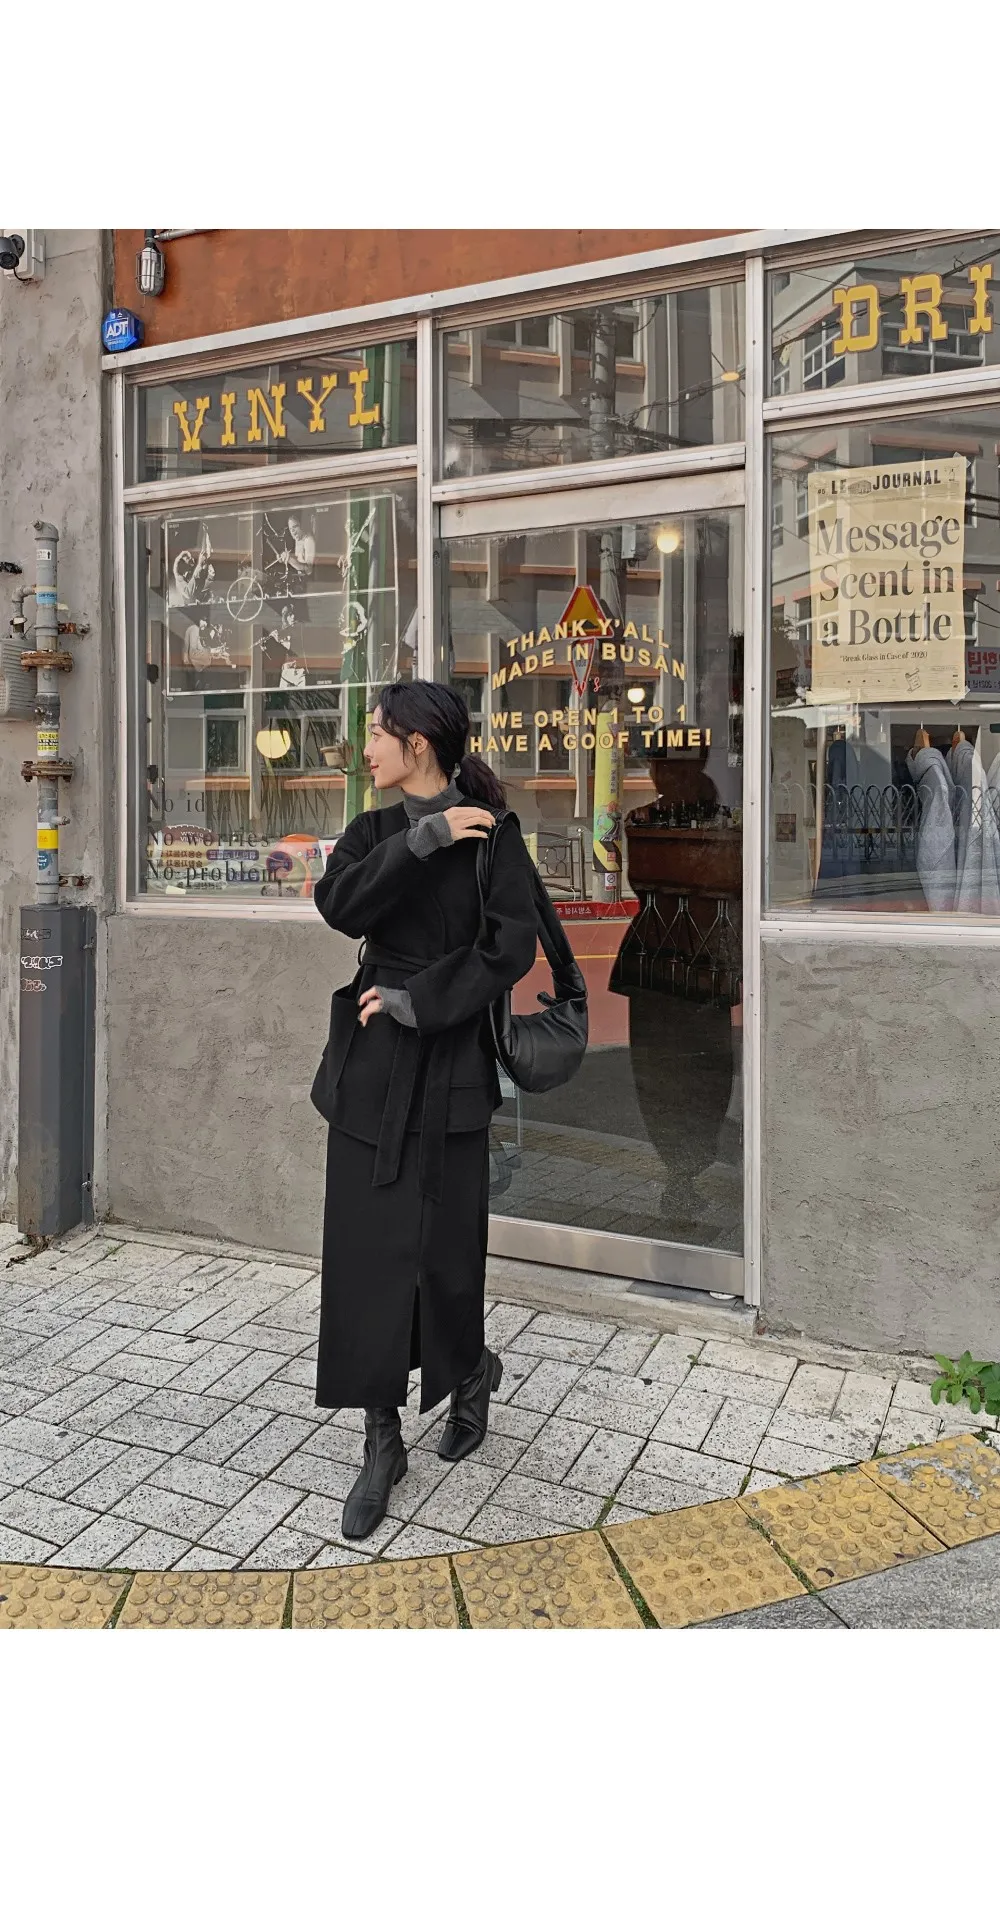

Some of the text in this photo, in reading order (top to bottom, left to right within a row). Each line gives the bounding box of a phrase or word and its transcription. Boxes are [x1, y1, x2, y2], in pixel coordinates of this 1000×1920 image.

[832, 263, 993, 355] DRI
[106, 321, 129, 339] ADT
[173, 367, 381, 452] VINYL
[831, 478, 847, 495] LE
[872, 469, 941, 491] JOURNAL
[815, 515, 961, 559] Message
[819, 560, 955, 602] Scent in
[506, 618, 670, 657] THANK Y'ALL
[822, 602, 953, 647] a Bottle
[491, 642, 686, 691] MADE IN BUSAN
[490, 704, 687, 729] WE OPEN 1 TO 1
[469, 728, 712, 753] HAVE A GOOF TIME!
[147, 825, 174, 847] No
[147, 858, 174, 881] No
